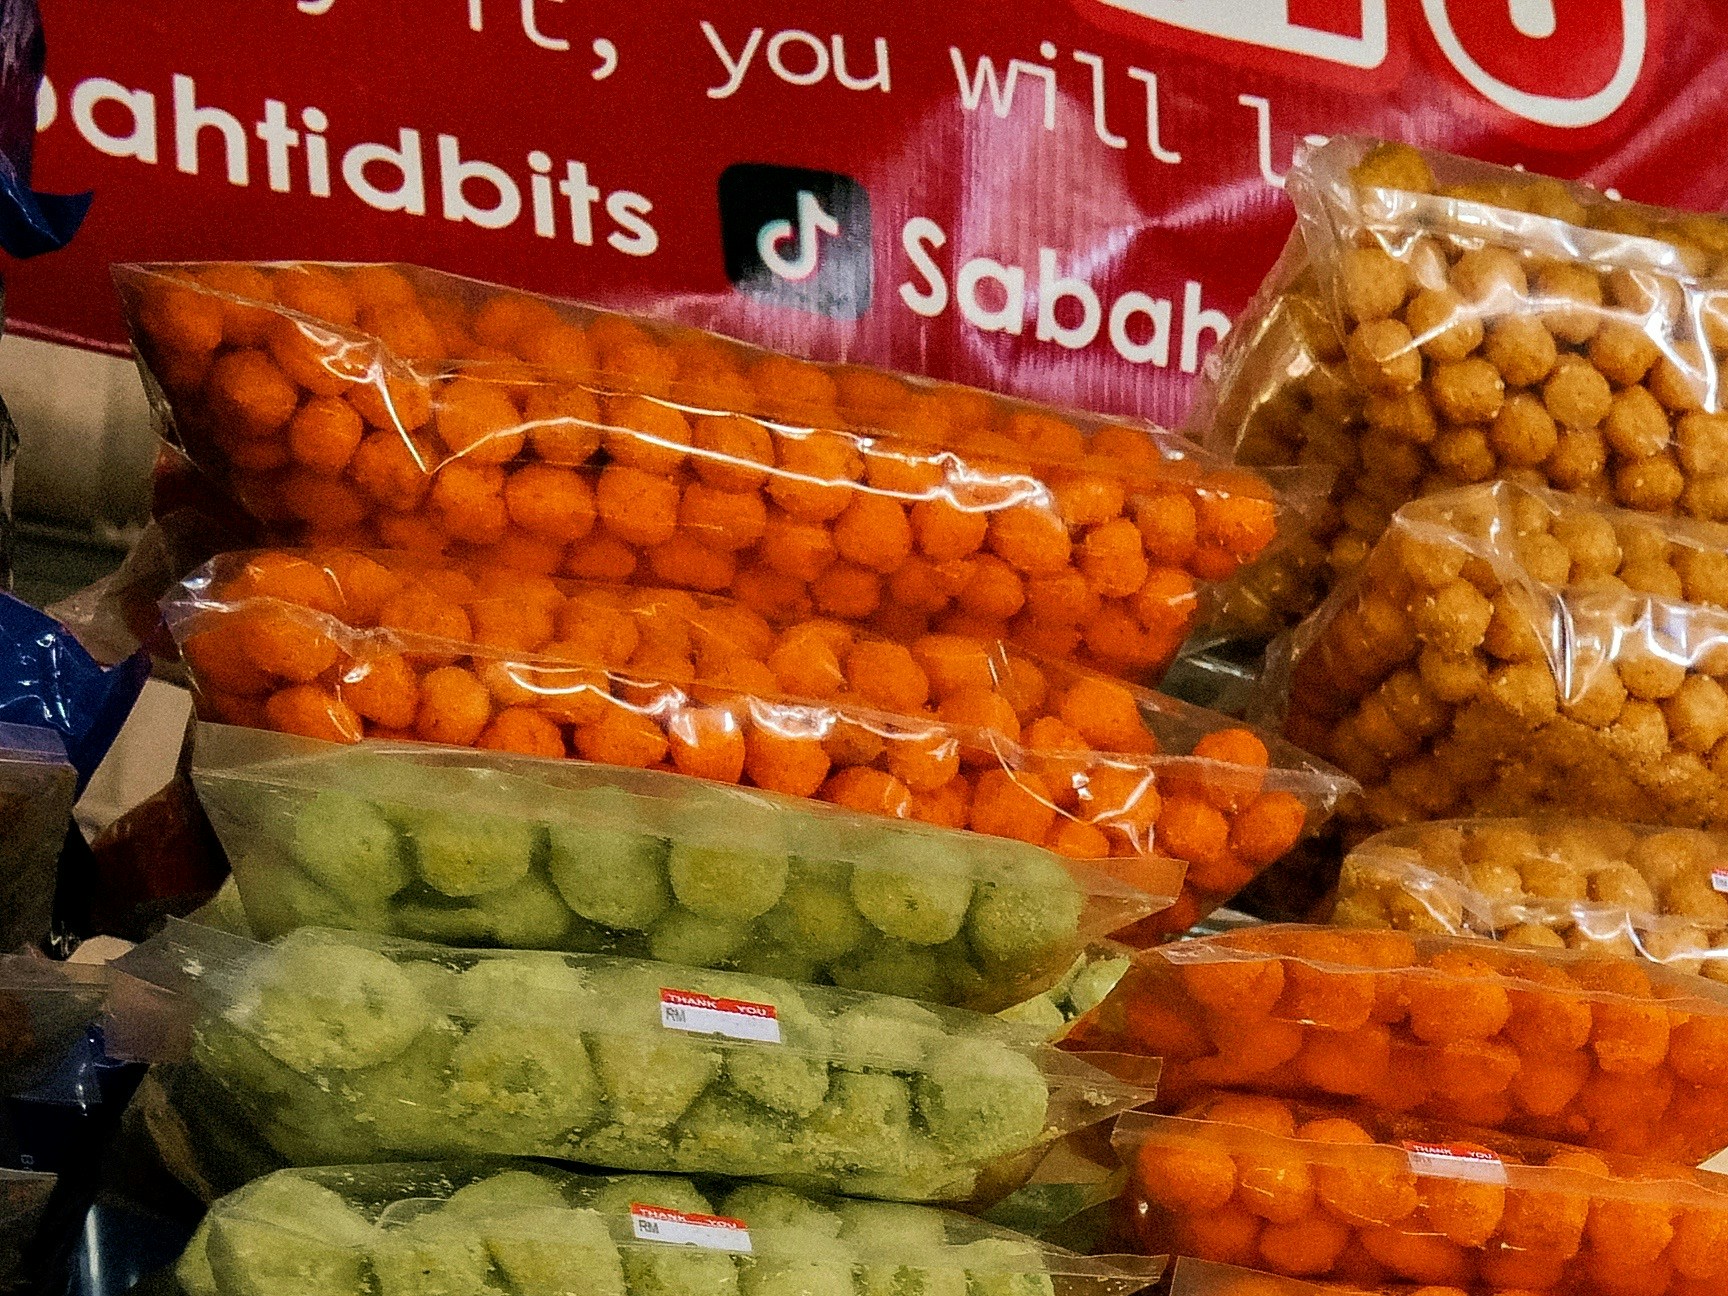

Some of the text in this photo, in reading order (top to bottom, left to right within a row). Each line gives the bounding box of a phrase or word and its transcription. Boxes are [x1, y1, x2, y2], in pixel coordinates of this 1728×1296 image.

[700, 20, 891, 98] you
[950, 42, 1182, 163] will
[667, 993, 767, 1016] THANK YOU
[666, 1008, 686, 1023] RM
[1412, 1144, 1492, 1160] THANK YOU
[638, 1208, 737, 1230] THANK YOU
[638, 1220, 660, 1234] RM
